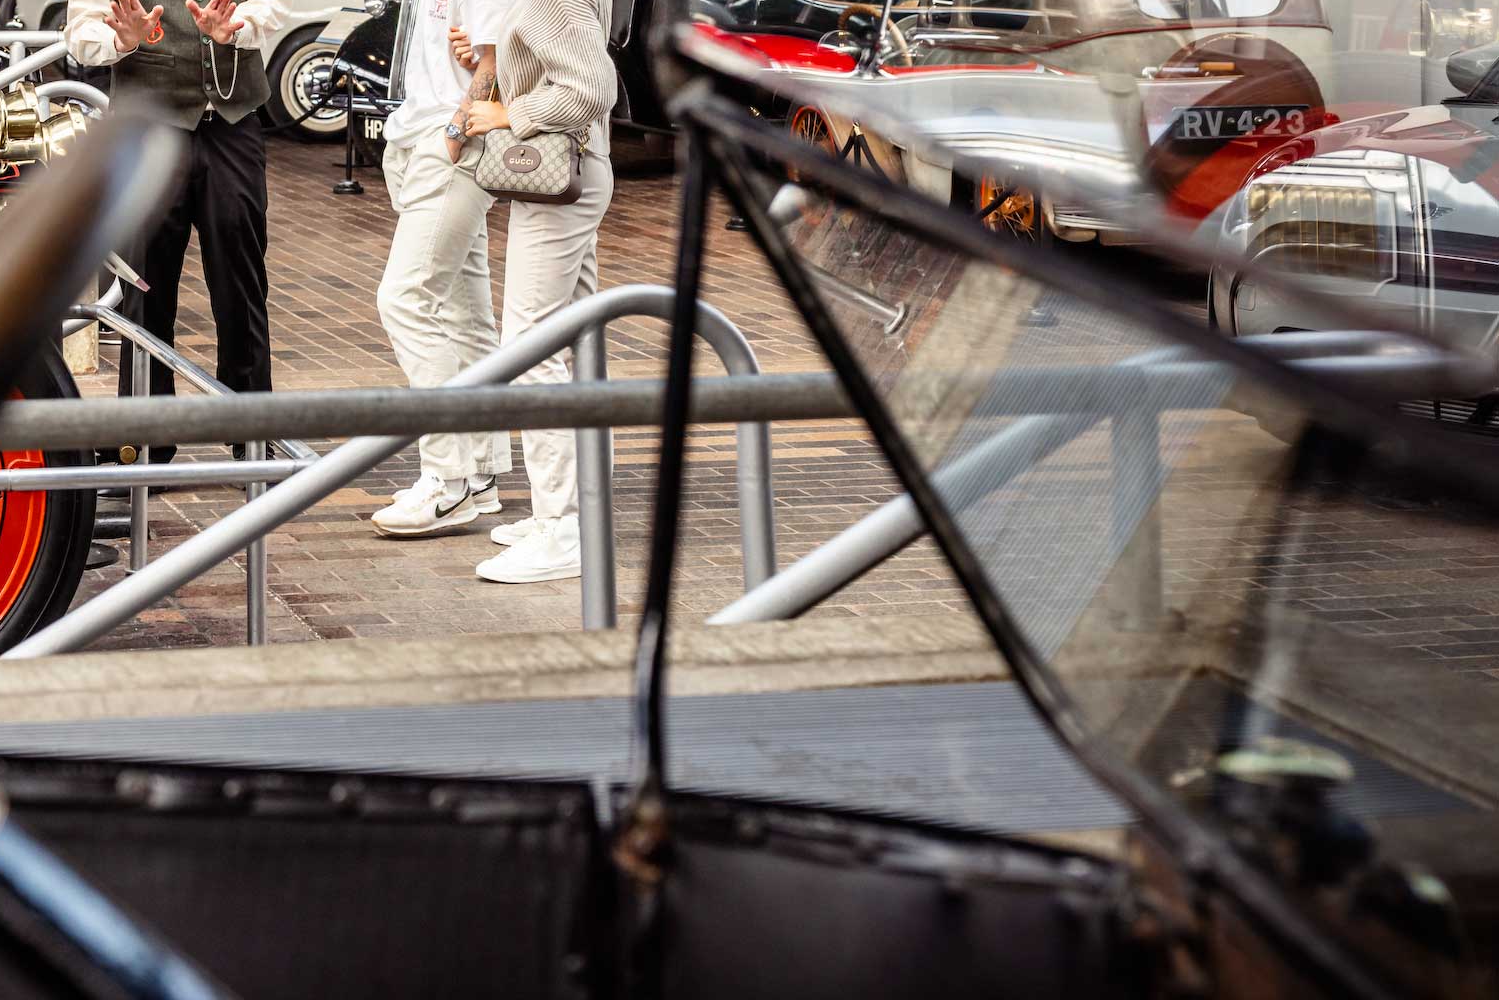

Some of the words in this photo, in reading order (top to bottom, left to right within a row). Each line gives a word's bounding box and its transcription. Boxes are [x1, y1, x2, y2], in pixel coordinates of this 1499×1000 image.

[1183, 110, 1224, 137] RV
[1237, 108, 1306, 136] 423
[509, 157, 534, 166] GUCCI
